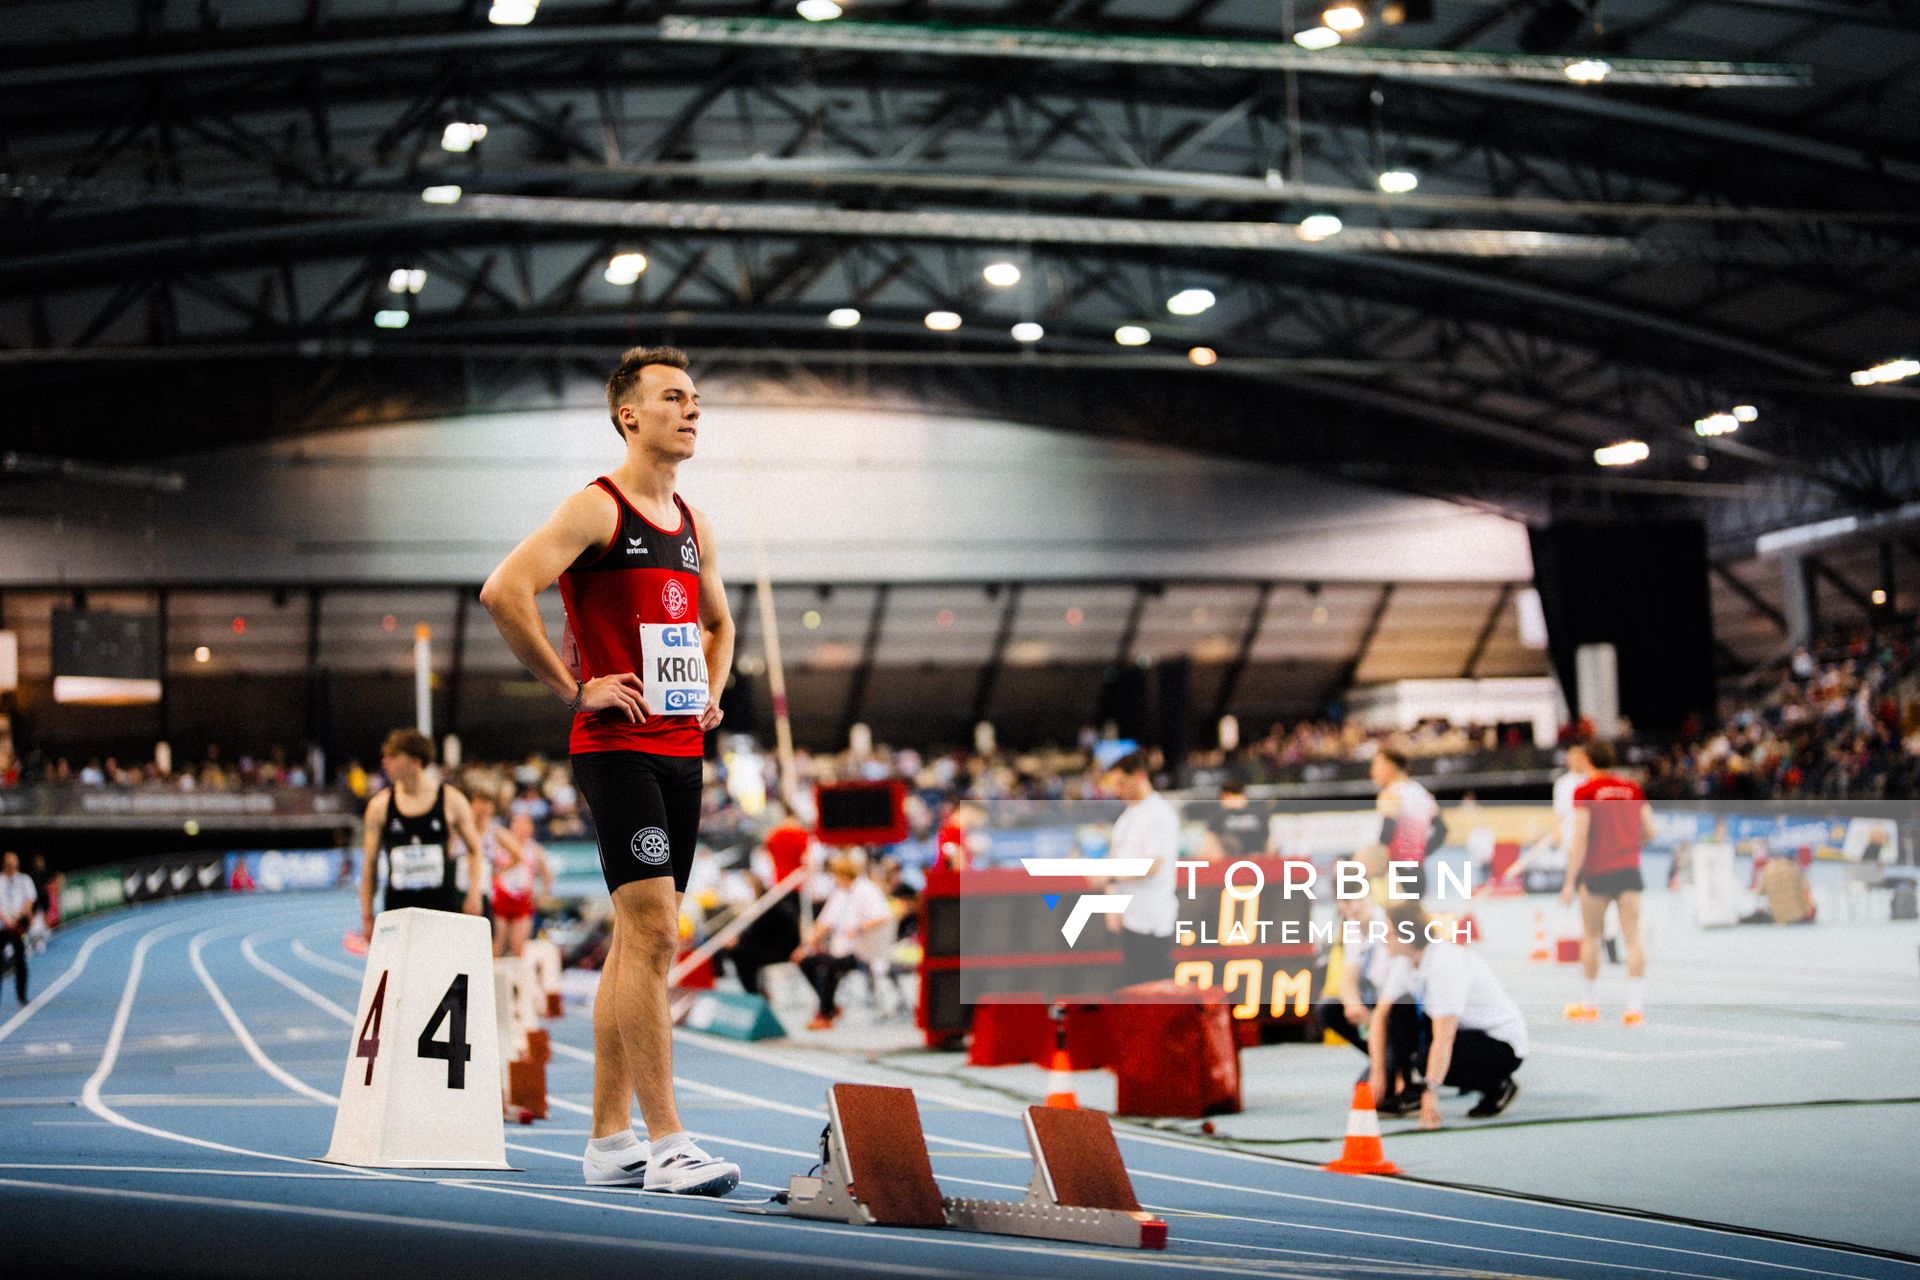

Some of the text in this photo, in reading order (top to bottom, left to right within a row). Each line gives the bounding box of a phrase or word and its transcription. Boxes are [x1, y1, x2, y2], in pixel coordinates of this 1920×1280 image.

[626, 547, 649, 555] erima
[356, 969, 389, 1087] 4
[417, 973, 472, 1090] 4
